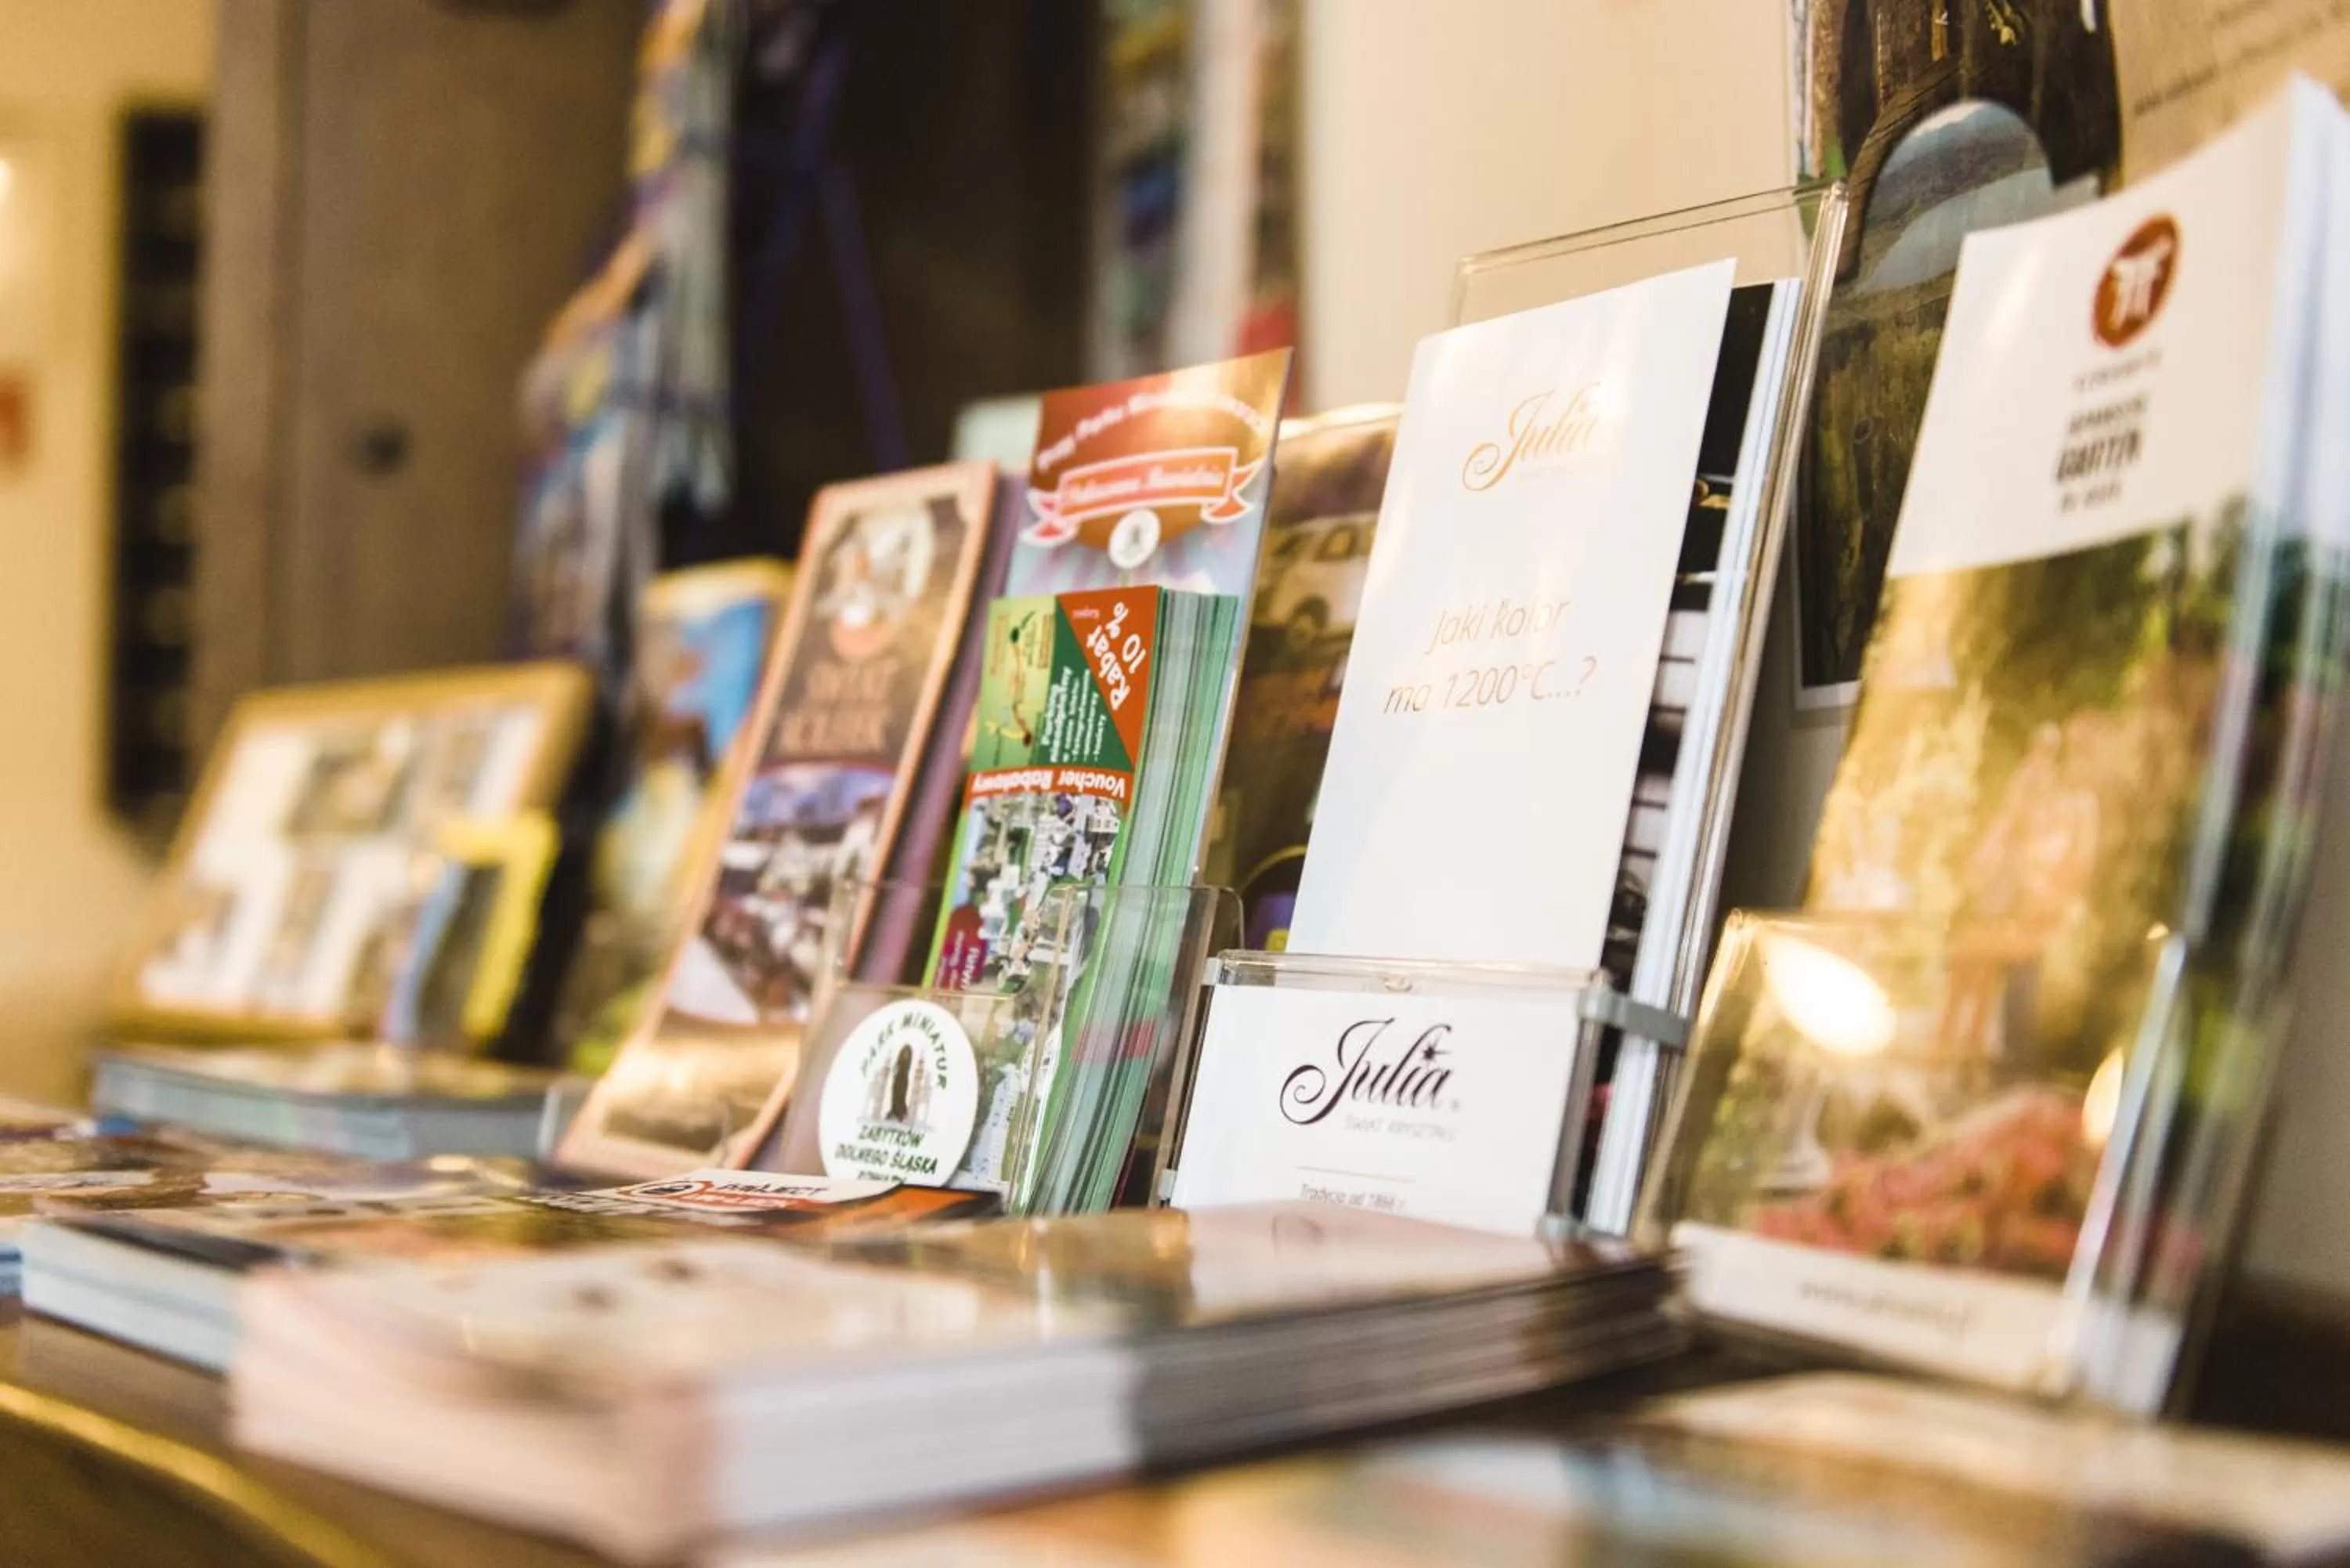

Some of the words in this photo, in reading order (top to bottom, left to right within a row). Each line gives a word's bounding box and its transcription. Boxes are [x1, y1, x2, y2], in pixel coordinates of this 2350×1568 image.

[1424, 603, 1488, 655] Jaki
[1086, 624, 1131, 710] Rabat
[1122, 634, 1147, 674] 10
[973, 769, 1054, 792] Rabatowy
[1058, 770, 1126, 799] Voucher
[1280, 1017, 1454, 1125] Julia
